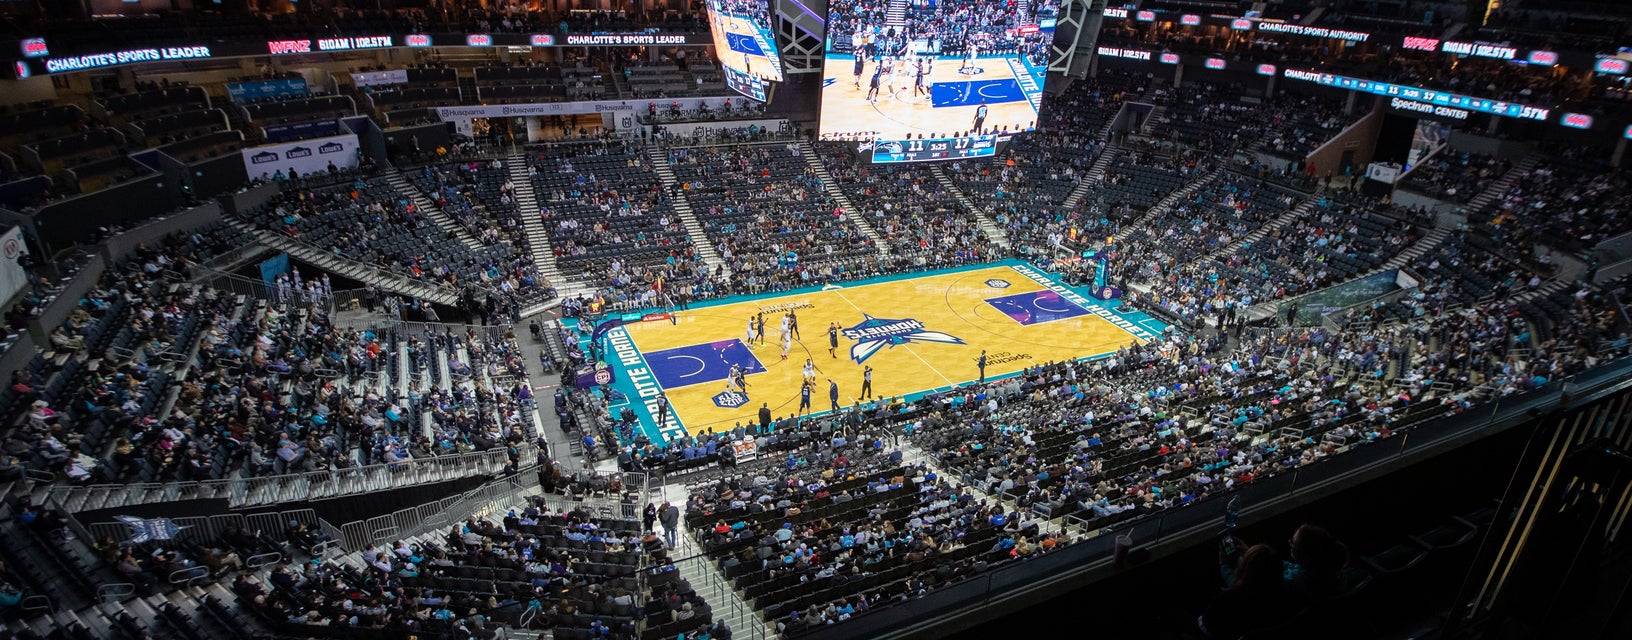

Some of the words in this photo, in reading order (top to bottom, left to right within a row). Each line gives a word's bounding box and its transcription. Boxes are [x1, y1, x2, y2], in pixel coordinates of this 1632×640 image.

[1259, 22, 1304, 35] CHARLOTTE'S
[1303, 27, 1330, 38] SPORTS
[1329, 30, 1370, 42] AUTHORITY
[567, 35, 622, 44] CHARLOTTE'S
[623, 36, 654, 44] SPORTS
[656, 35, 686, 44] LEADER
[268, 40, 311, 54] WFNZ
[46, 53, 118, 73] CHARLOTTE'S
[117, 49, 160, 63] SPORTS
[161, 46, 211, 59] LEADER
[449, 108, 485, 117] Husqvarna
[510, 106, 544, 115] Husqvarna
[602, 103, 633, 112] Husqvarna
[1391, 97, 1433, 113] Spectrum
[1435, 106, 1469, 120] CENTER
[909, 141, 924, 152] 11
[930, 142, 947, 151] 3:25
[954, 138, 969, 149] 17
[1012, 265, 1089, 305] CHARLOTTE
[845, 319, 922, 341] HORNETS
[597, 373, 609, 381] CPI
